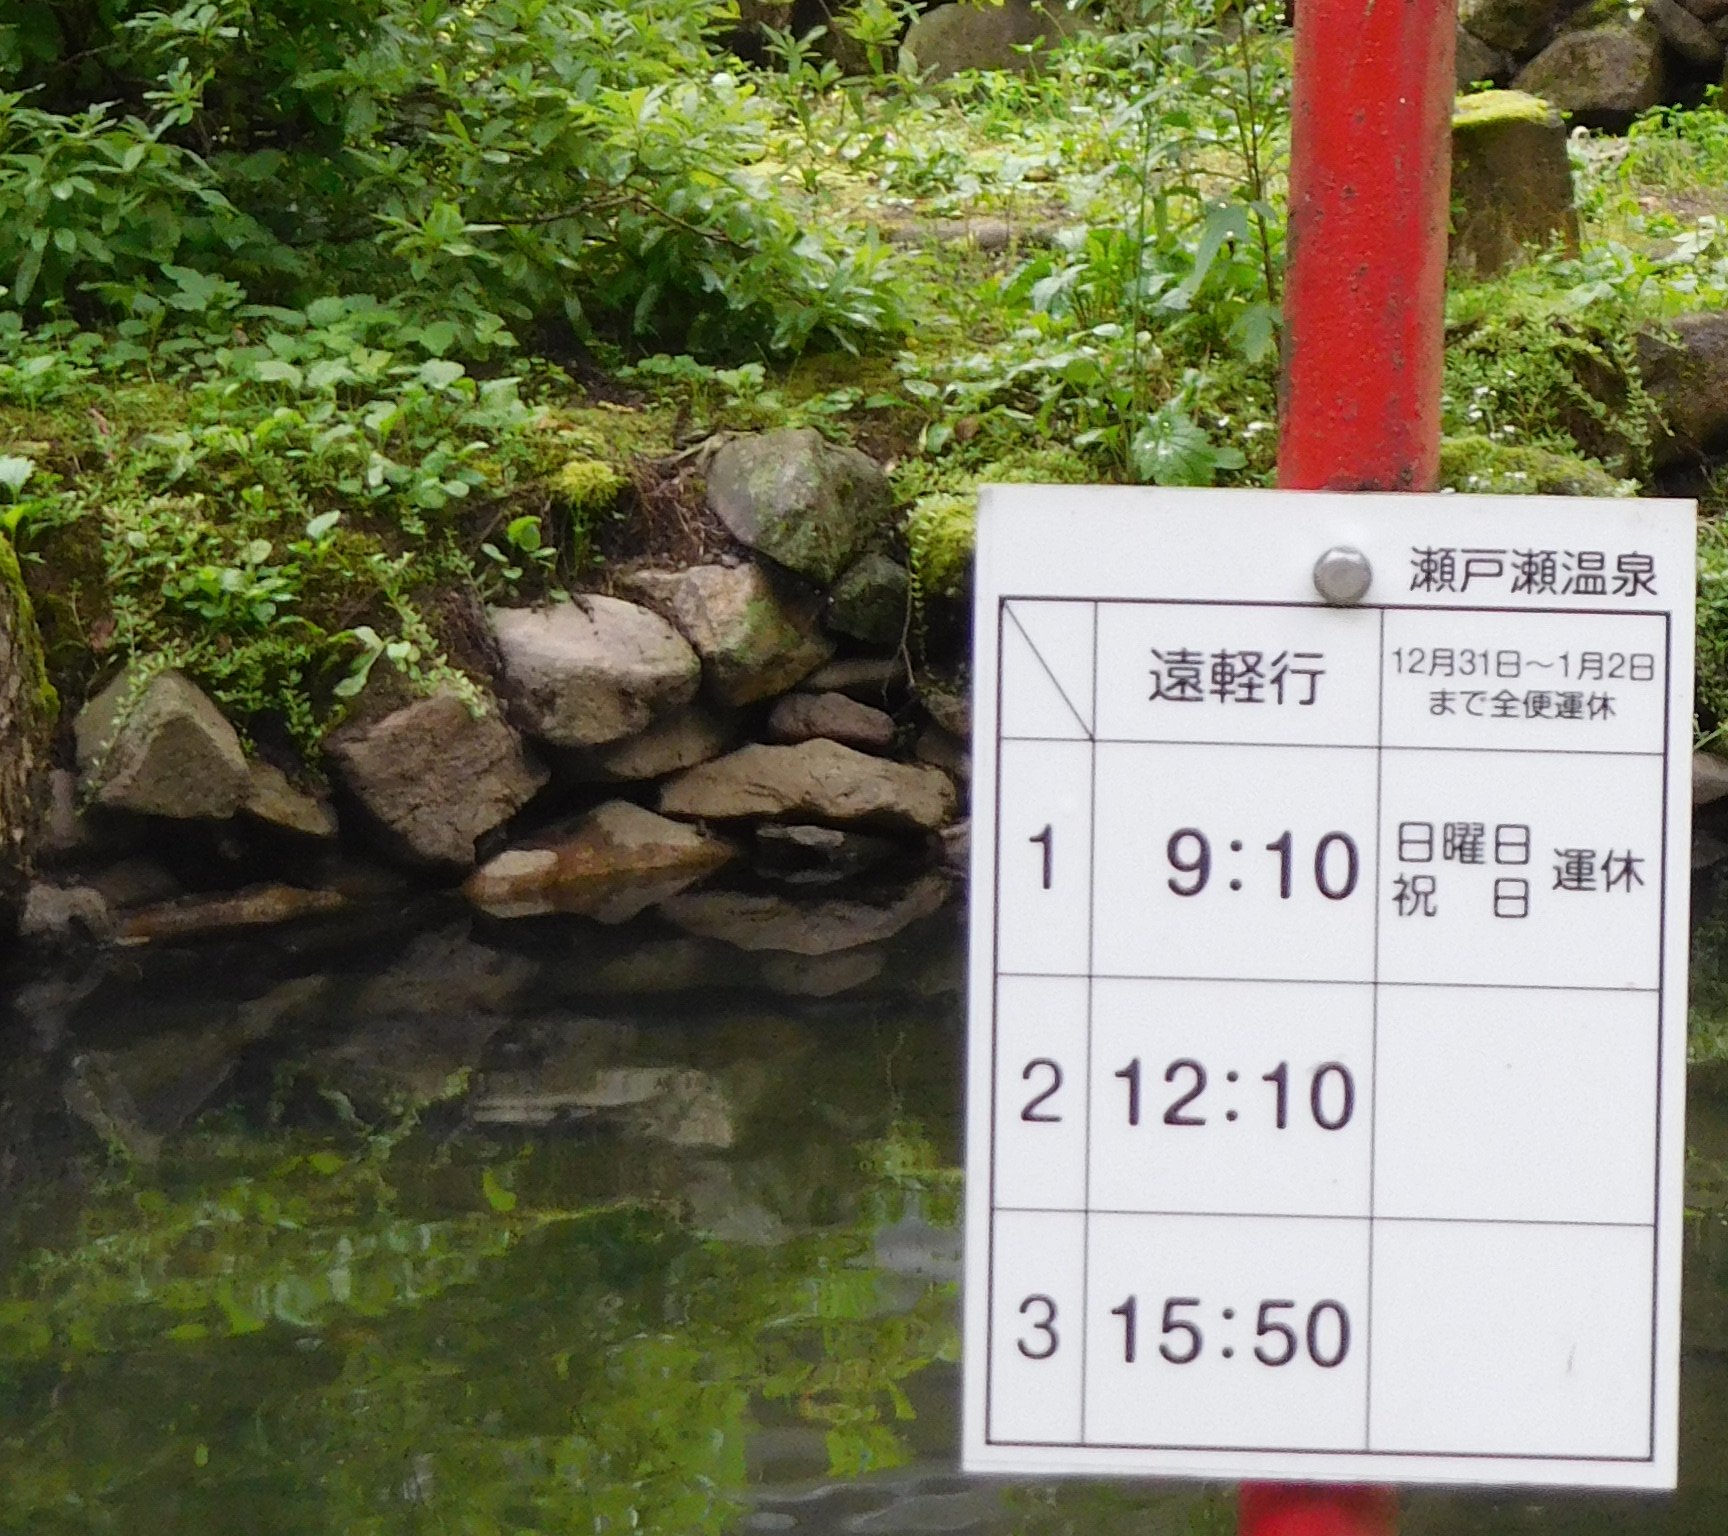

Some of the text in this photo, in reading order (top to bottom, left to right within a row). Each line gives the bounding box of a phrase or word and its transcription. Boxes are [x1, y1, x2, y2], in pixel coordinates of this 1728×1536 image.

[1409, 545, 1658, 597] 瀬戸瀬温泉
[1146, 647, 1328, 709] 遠軽行
[1429, 687, 1617, 721] まで全便運休
[1027, 823, 1055, 891] 1
[1164, 826, 1360, 903] 9:10
[1398, 821, 1530, 865] 日曜日
[1552, 848, 1645, 893] 運休
[1018, 1057, 1065, 1123] 2
[1113, 1056, 1357, 1132] 12:10
[1015, 1293, 1061, 1361] 3
[1109, 1294, 1353, 1369] 15:50
